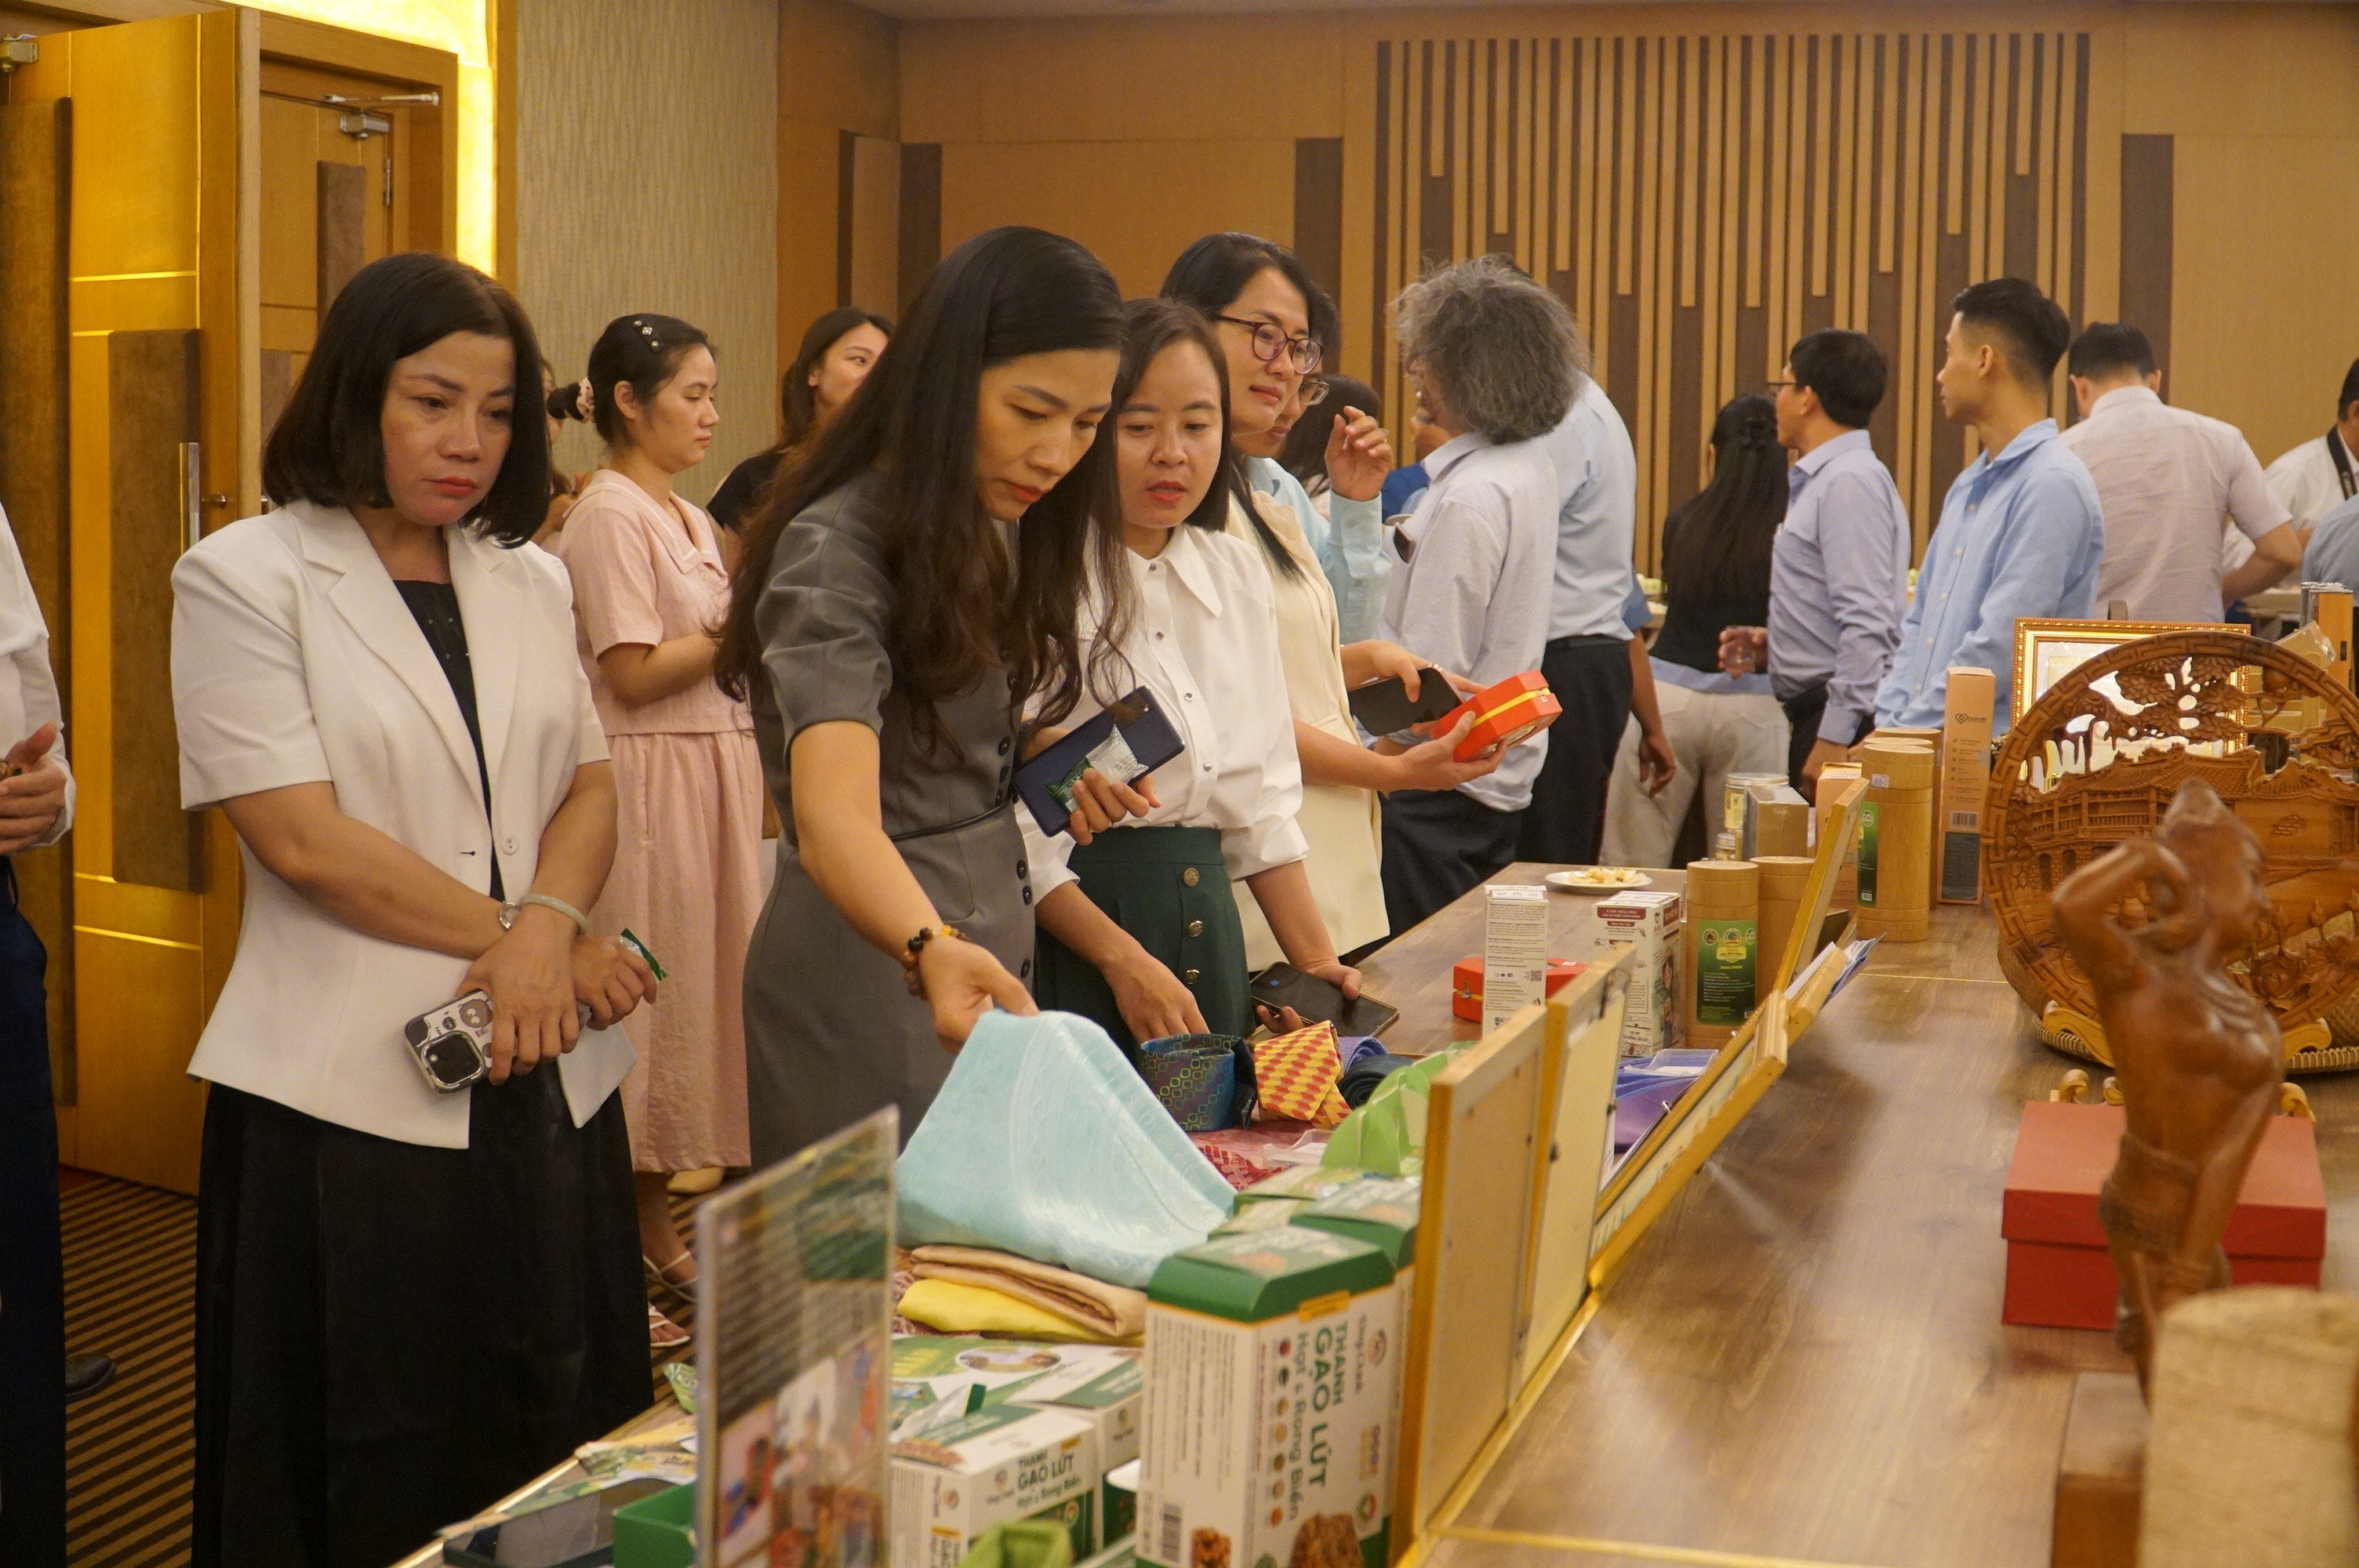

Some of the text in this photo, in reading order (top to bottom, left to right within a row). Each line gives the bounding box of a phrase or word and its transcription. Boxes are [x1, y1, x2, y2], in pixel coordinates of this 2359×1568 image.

[1308, 1327, 1333, 1411] GẠO
[1332, 1320, 1347, 1405] THANH
[1309, 1422, 1332, 1487] LỨT
